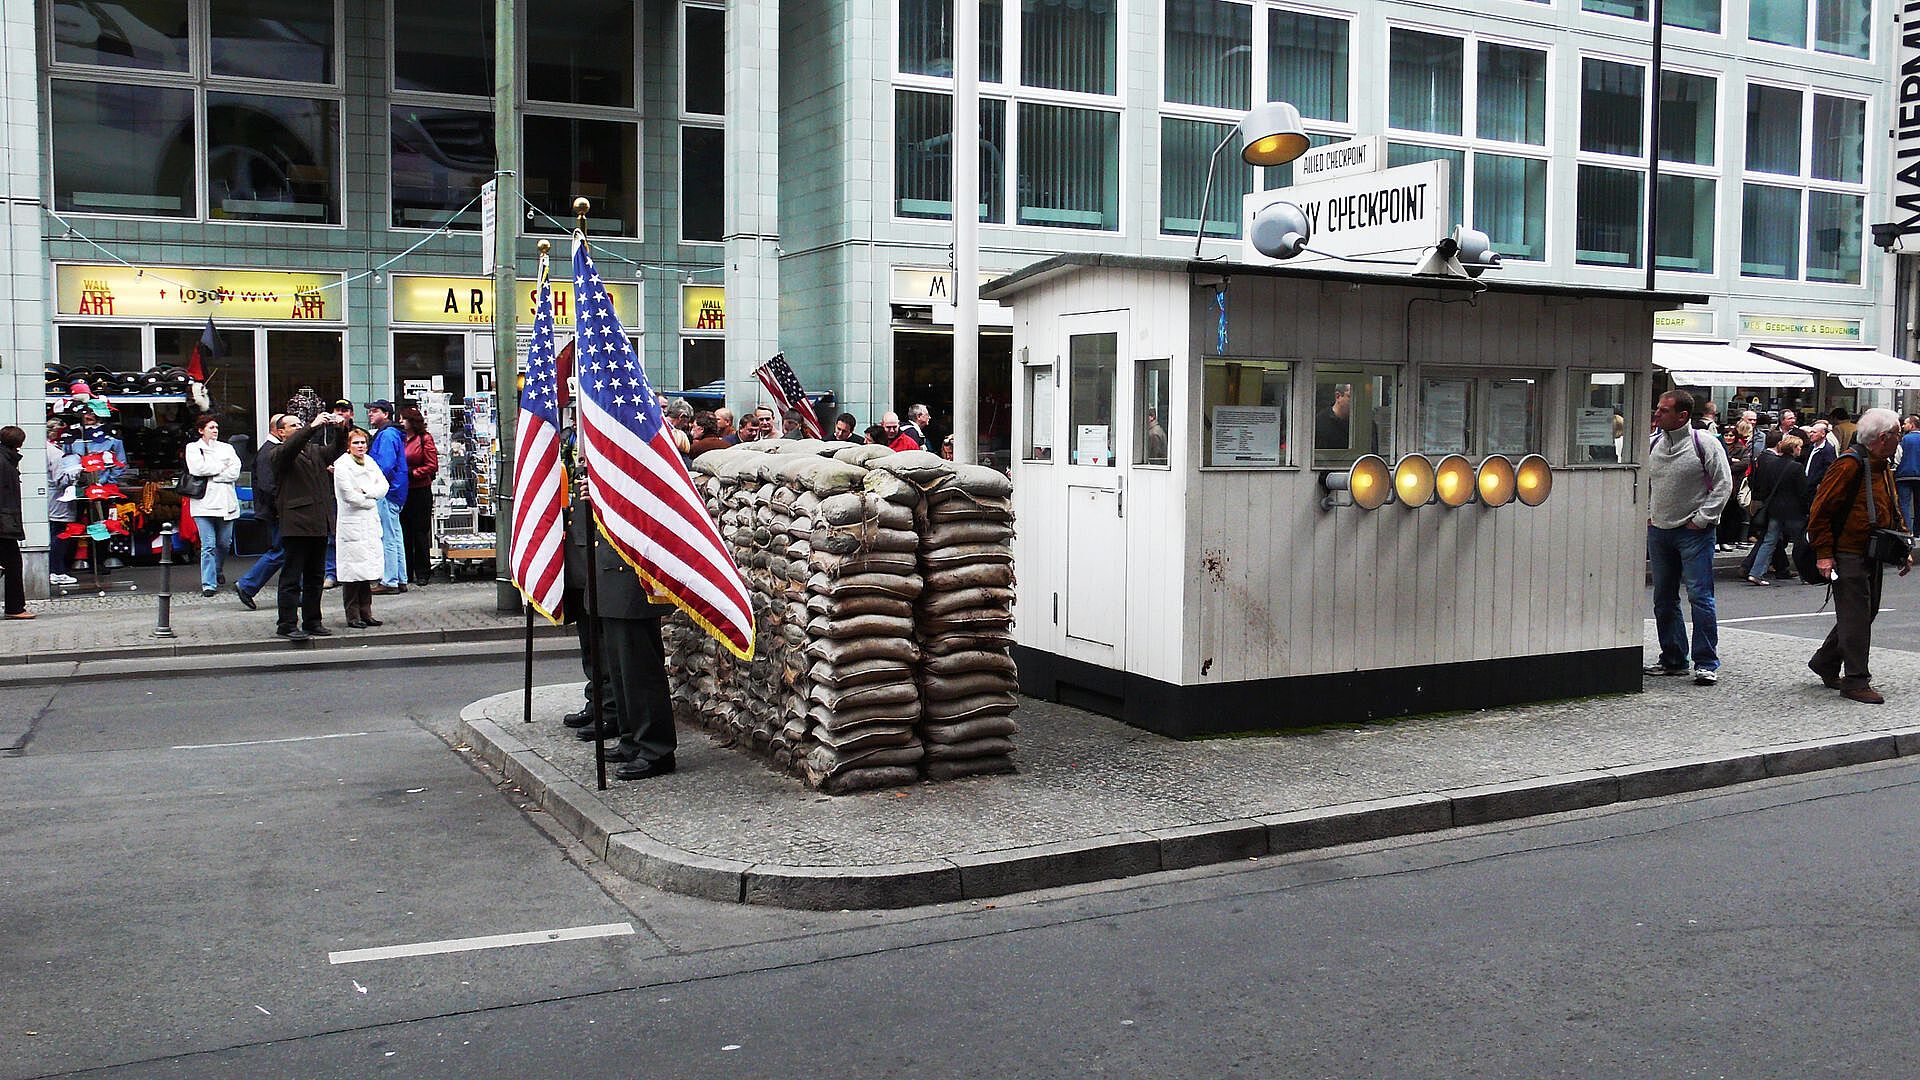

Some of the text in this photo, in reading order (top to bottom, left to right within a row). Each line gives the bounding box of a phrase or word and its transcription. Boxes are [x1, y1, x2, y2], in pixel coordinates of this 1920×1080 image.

[1303, 144, 1367, 174] ALLIED CHECKPOINT
[1328, 183, 1427, 232] CHECKPOINT
[84, 279, 110, 290] WALL
[79, 294, 115, 315] ART
[291, 298, 325, 319] ART
[702, 299, 721, 309] WALL
[696, 311, 726, 330] ART
[1655, 317, 1686, 326] BEDARF
